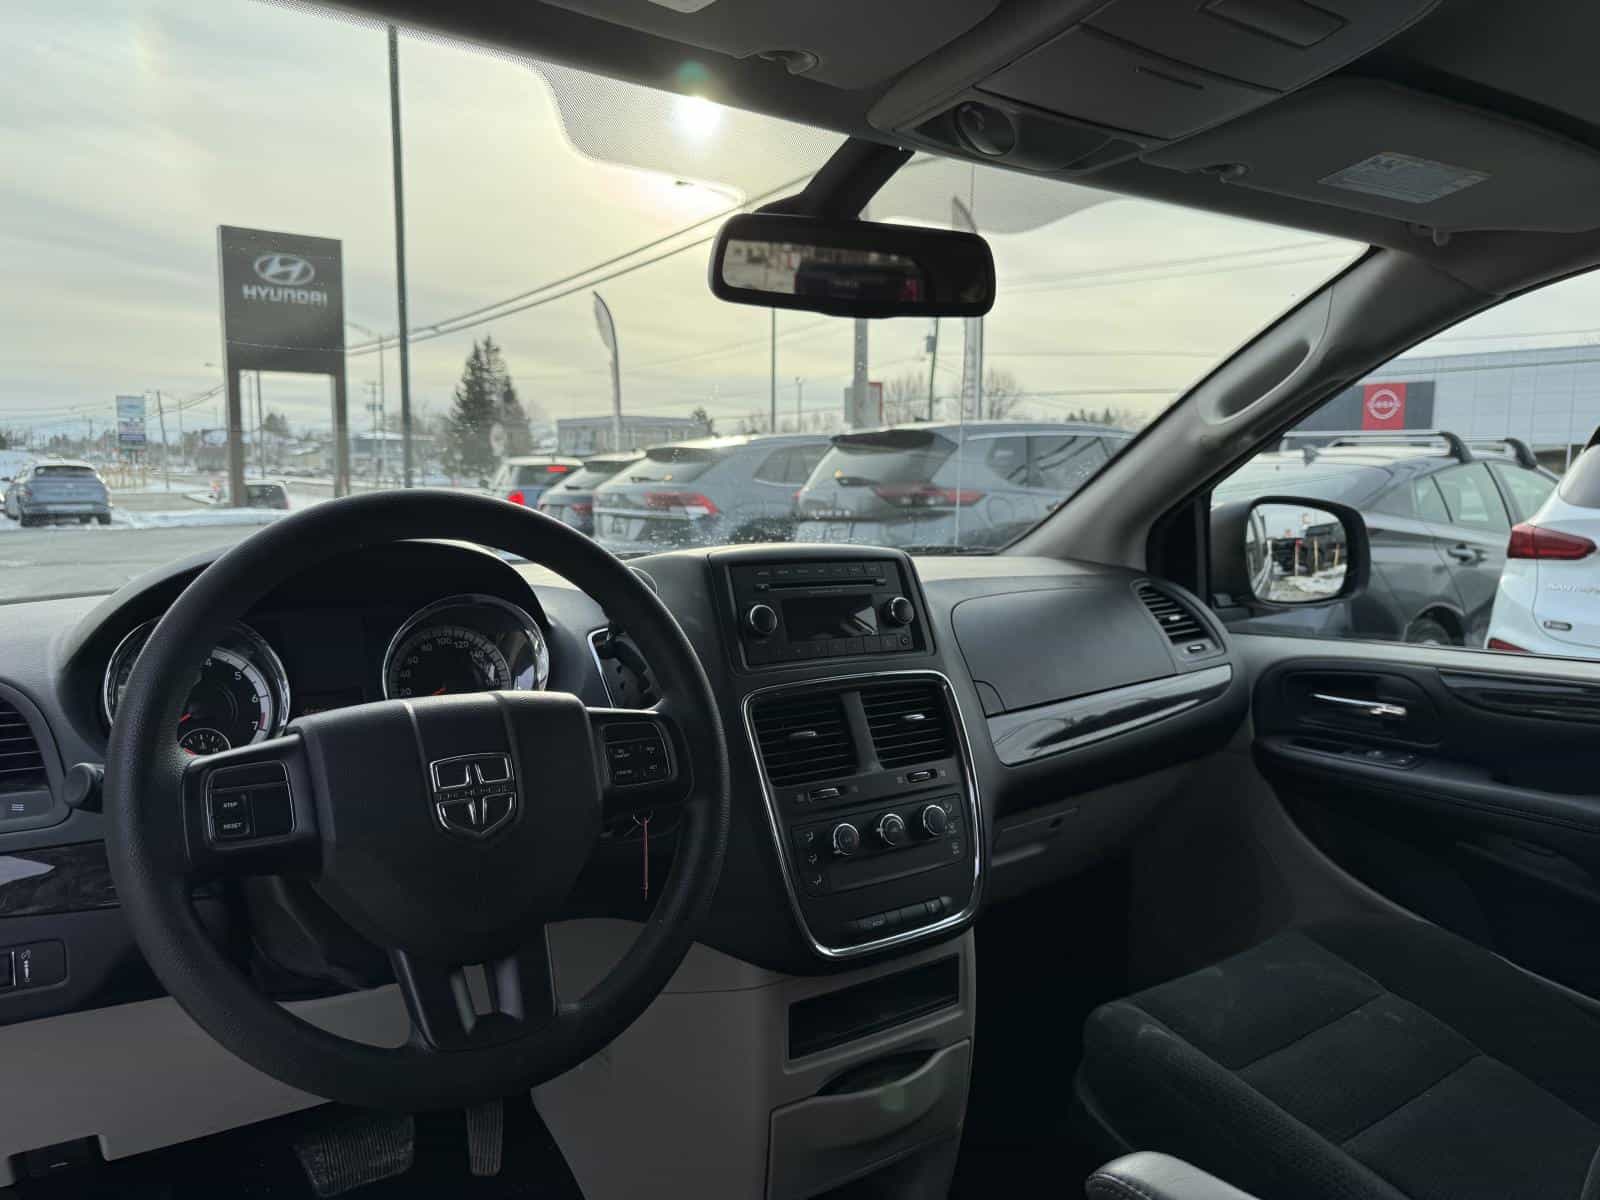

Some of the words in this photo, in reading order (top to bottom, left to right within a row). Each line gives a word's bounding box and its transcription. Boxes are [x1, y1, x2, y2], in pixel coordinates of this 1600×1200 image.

[242, 284, 328, 306] HYUNDAI
[233, 671, 243, 681] 5
[251, 694, 260, 704] 6
[251, 720, 259, 731] 7
